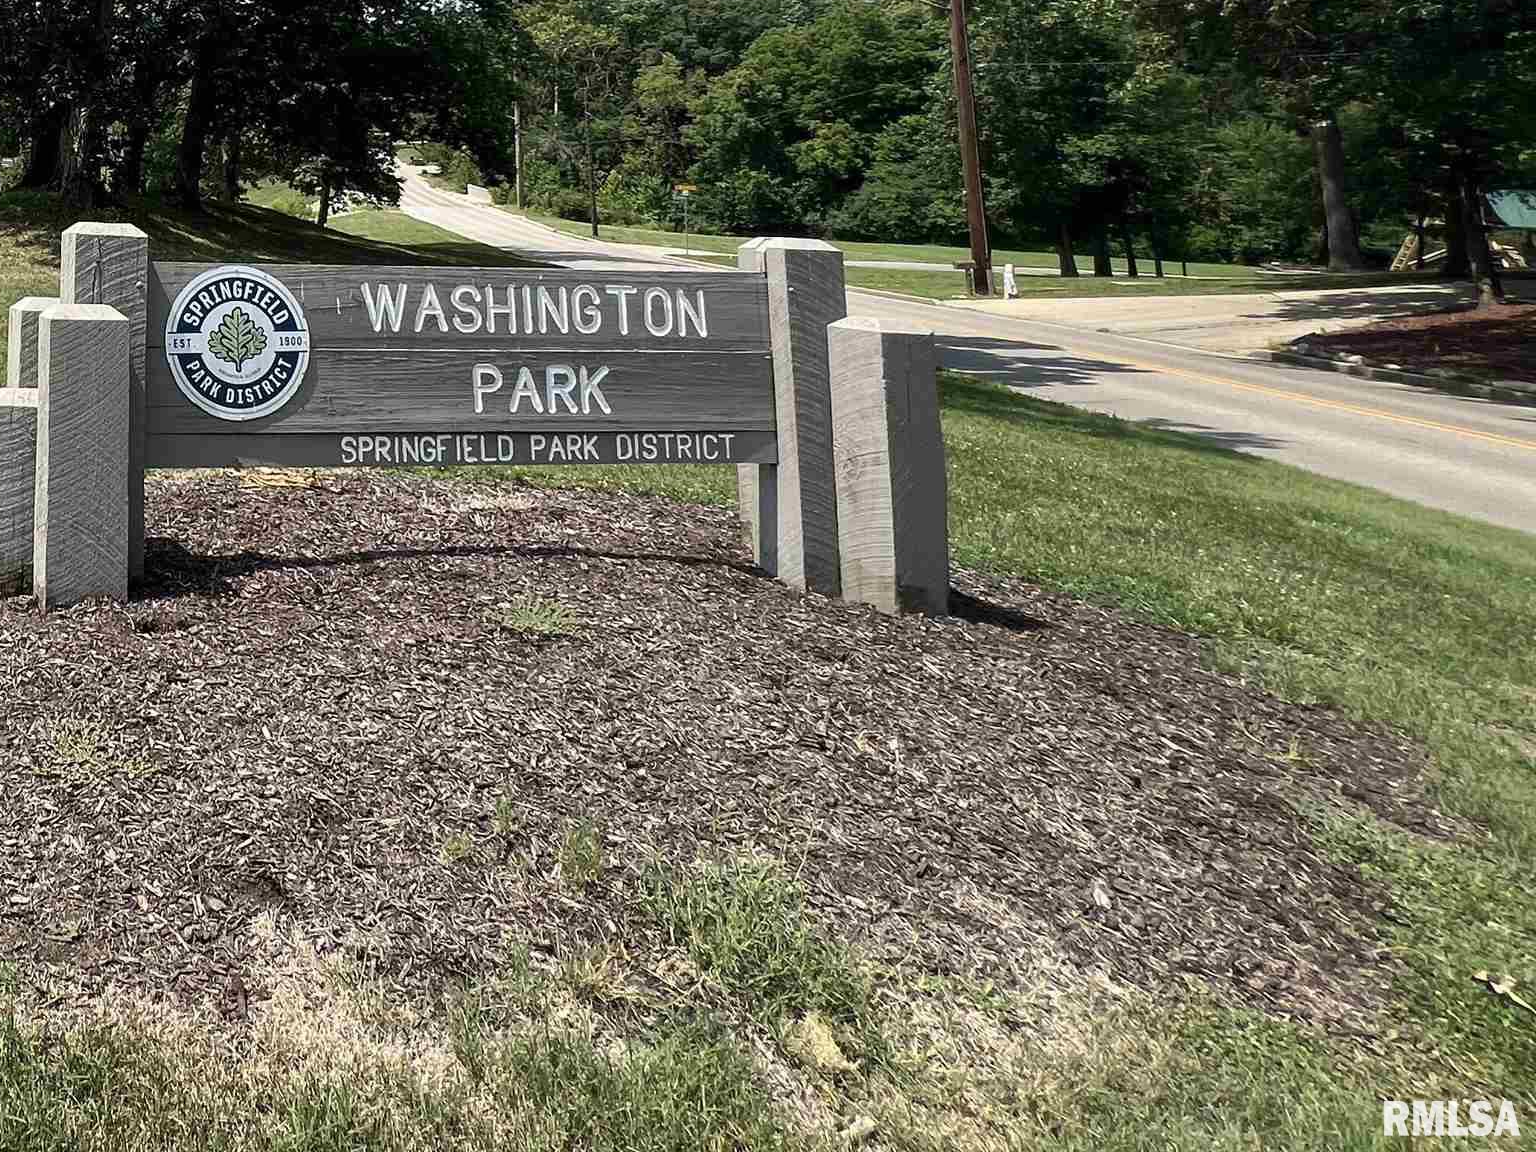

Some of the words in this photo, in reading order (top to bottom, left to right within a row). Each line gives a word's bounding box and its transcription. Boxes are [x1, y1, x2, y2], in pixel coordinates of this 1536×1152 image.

[183, 280, 289, 326] SPRINGFIELD
[361, 282, 708, 338] WASHINGTON
[279, 336, 302, 346] 1900
[186, 360, 222, 398] PARK
[226, 358, 292, 404] DISTRICT
[472, 363, 612, 414] PARK
[340, 435, 514, 464] SPRINGFIELD
[530, 434, 600, 461] PARK
[616, 433, 736, 461] DISTRICT
